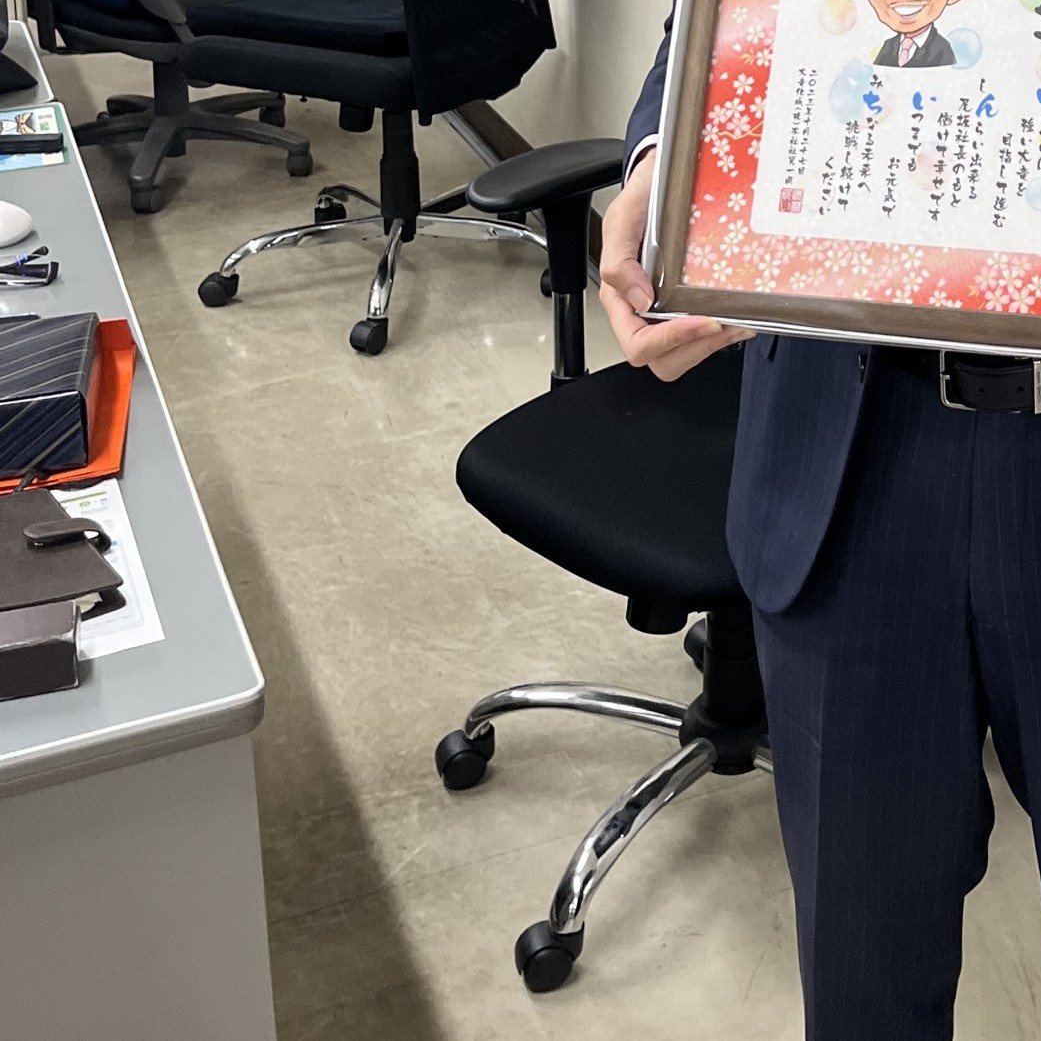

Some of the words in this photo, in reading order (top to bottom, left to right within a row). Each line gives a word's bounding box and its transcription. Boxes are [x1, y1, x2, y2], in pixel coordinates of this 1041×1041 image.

[837, 120, 860, 211] 挑戦し続けて
[857, 74, 884, 192] みちなる未来へ
[908, 91, 937, 172] いつまでも
[928, 112, 953, 221] 働けて幸せです
[950, 97, 972, 208] 尾坂社長のもと
[967, 78, 999, 200] しんらい出来る
[1016, 117, 1034, 197] 強い大竜を
[819, 156, 836, 215] ください
[881, 157, 901, 218] お元気で
[992, 133, 1013, 228] 目指して進む
